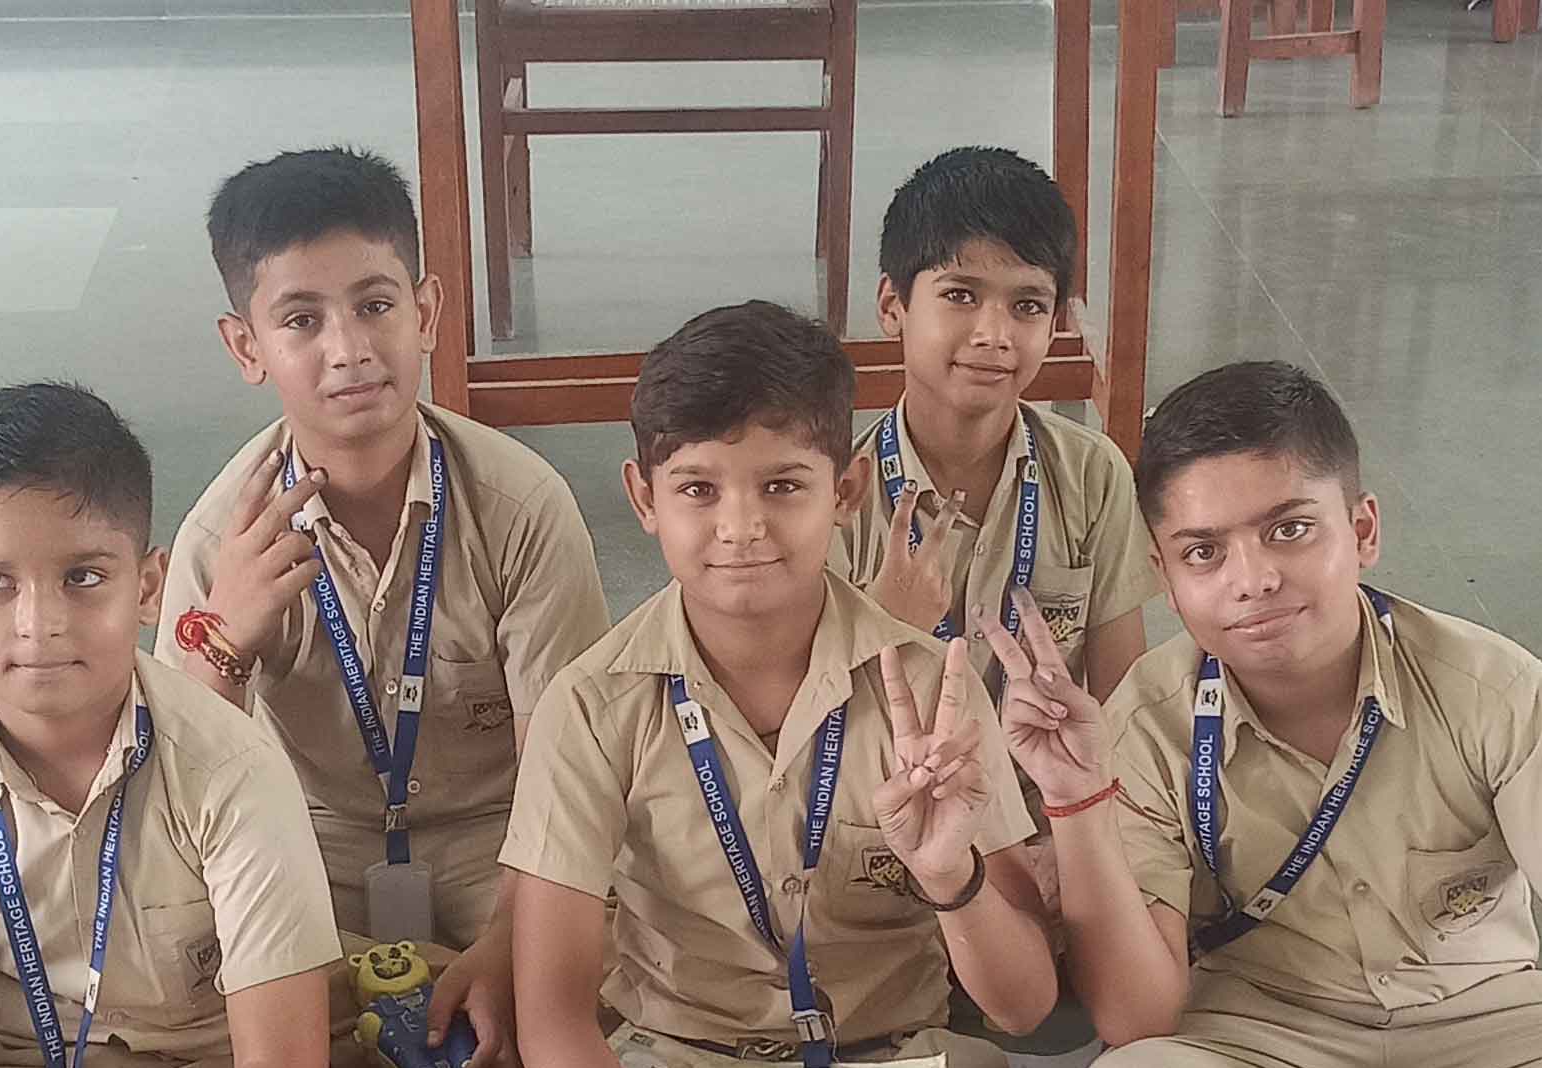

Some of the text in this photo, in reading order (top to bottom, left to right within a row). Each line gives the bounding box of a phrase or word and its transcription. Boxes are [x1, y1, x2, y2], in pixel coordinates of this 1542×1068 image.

[422, 517, 439, 583] HERITAGE
[1021, 490, 1036, 555] SCHOOL
[414, 583, 431, 630] INDIAN
[314, 571, 386, 755] THE INDIAN HERITAGE SCHOO
[411, 630, 427, 658] THE
[132, 727, 151, 773] HOOL
[810, 708, 844, 849] THE INDIAN HERITA
[1197, 733, 1213, 798] SCHOOL
[697, 759, 728, 822] SCHOOL
[1283, 703, 1381, 880] THE INDIAN HERITAGE SCH
[718, 823, 756, 897] HERITAGE
[98, 866, 114, 920] INDIAN
[8, 897, 40, 975] HERITAGE
[93, 921, 107, 950] THE
[27, 976, 56, 1026] INDIAN
[44, 1030, 61, 1062] THE
